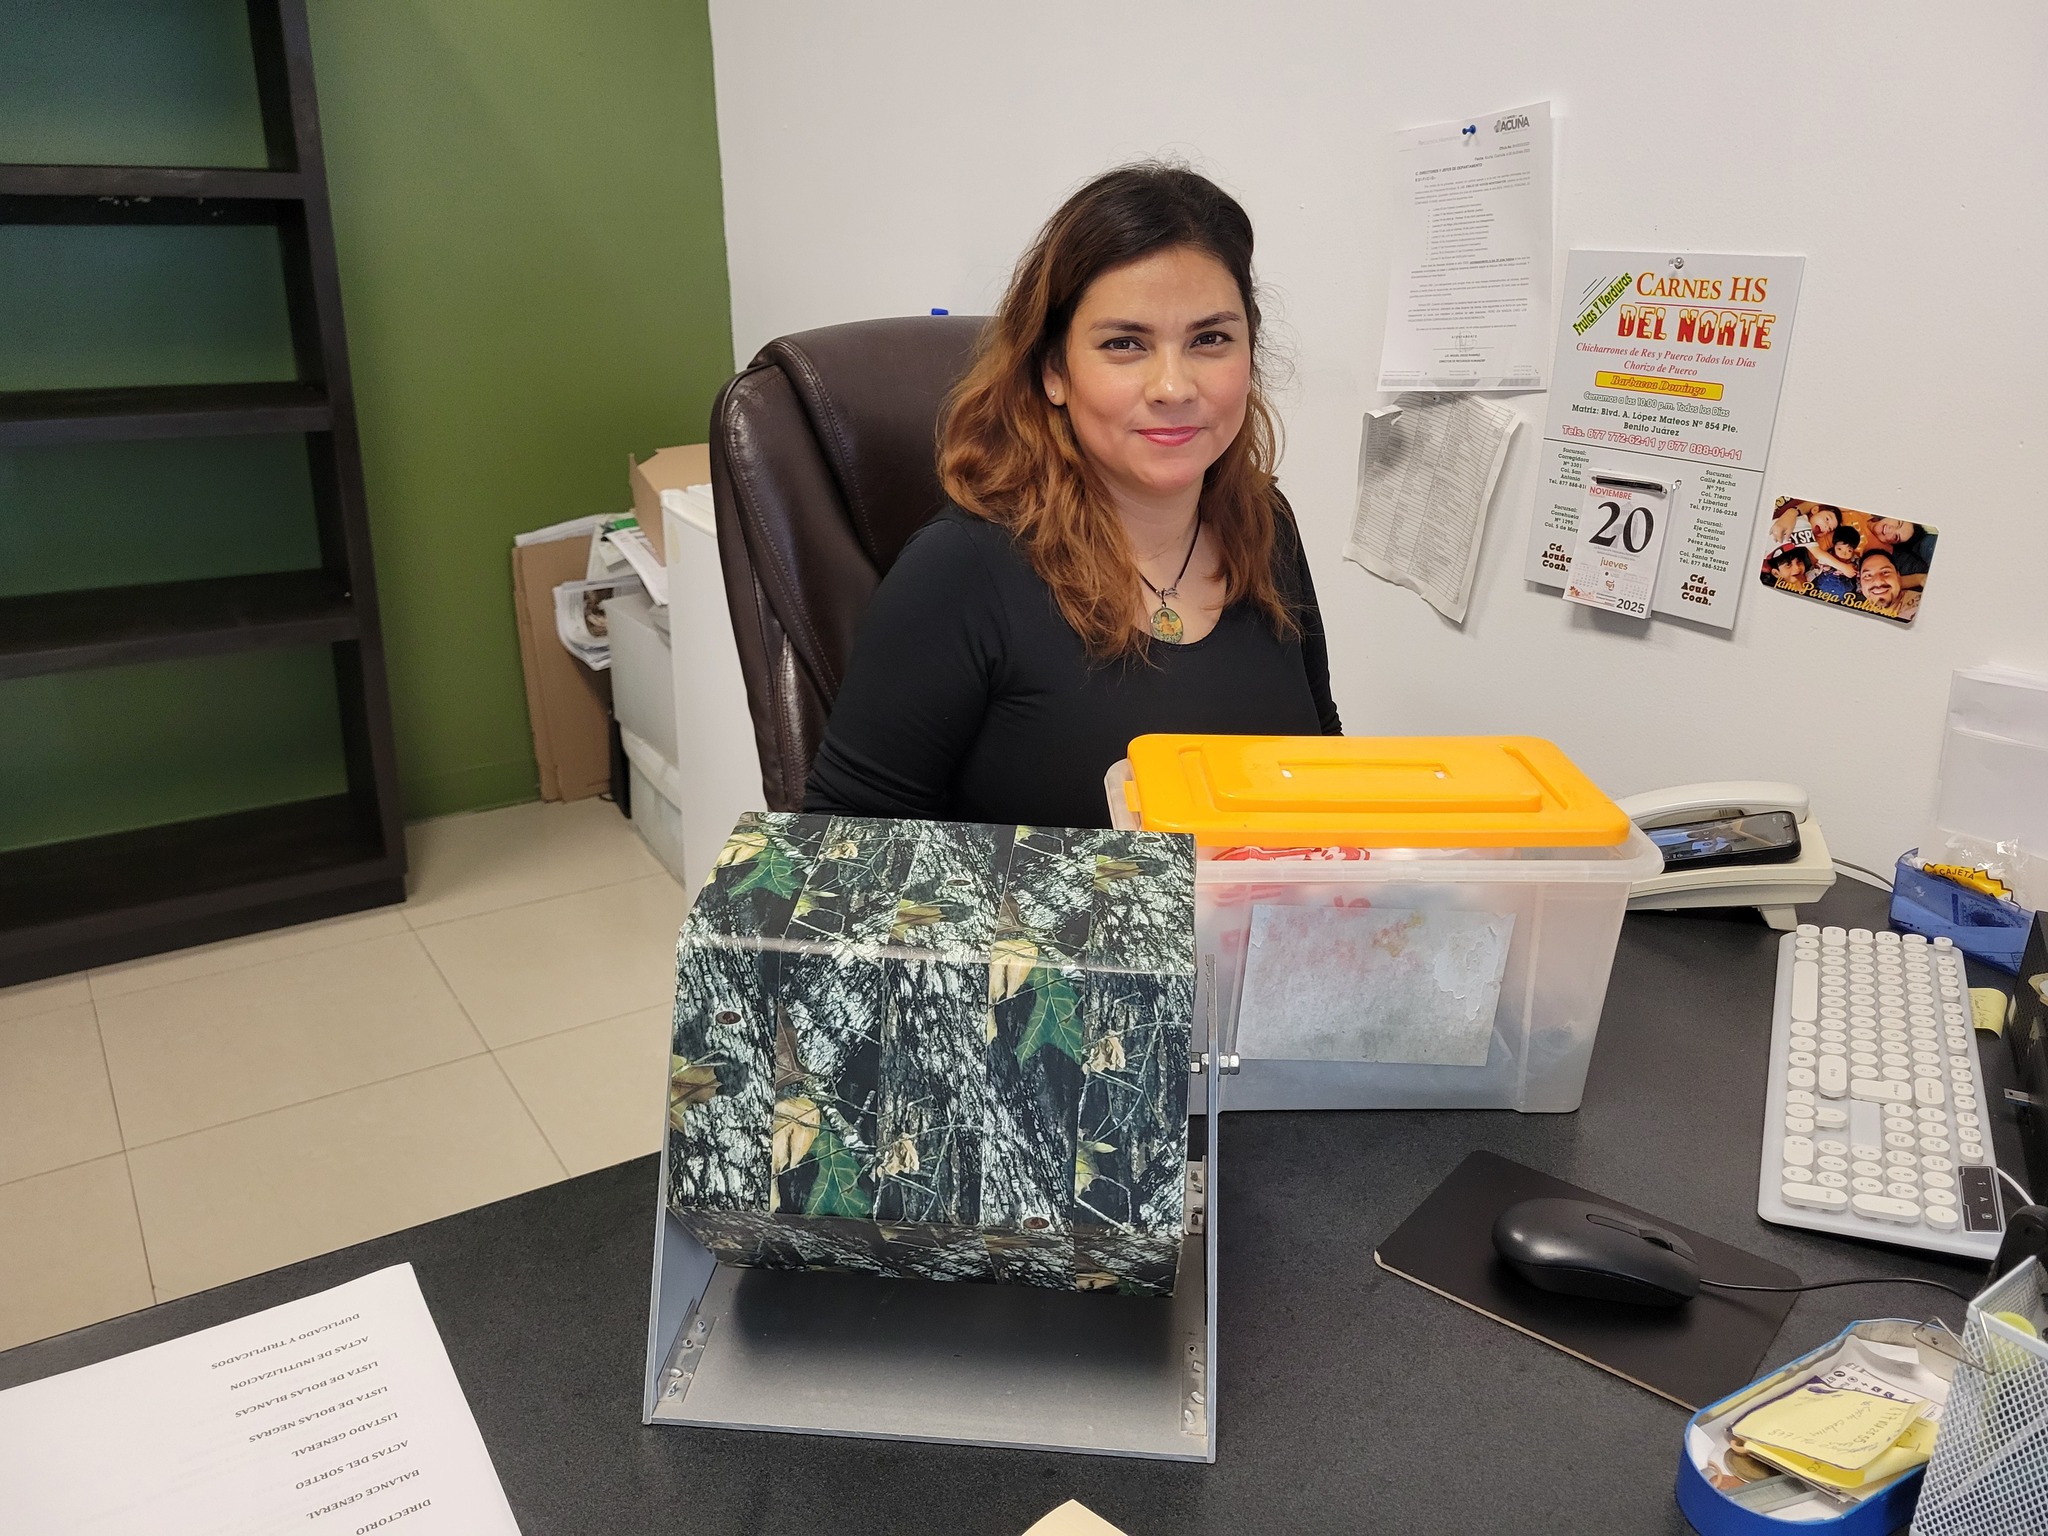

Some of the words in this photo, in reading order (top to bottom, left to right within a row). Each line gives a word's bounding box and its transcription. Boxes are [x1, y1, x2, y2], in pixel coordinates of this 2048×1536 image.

[1500, 115, 1530, 132] ACUÑA
[1729, 277, 1768, 303] HS
[1572, 309, 1598, 336] Frutas
[1593, 301, 1603, 314] Y
[1598, 272, 1633, 308] Verduras
[1617, 304, 1667, 340] DEL
[1677, 308, 1776, 349] NORTE
[1576, 342, 1628, 356] Chicharrones
[1629, 347, 1640, 356] de
[1640, 348, 1656, 358] Res
[1656, 351, 1663, 361] y
[1663, 350, 1693, 362] Puerco
[1695, 353, 1720, 364] Todos
[1721, 356, 1733, 366] los
[1736, 356, 1757, 368] Días
[1623, 360, 1656, 372] Chorizo
[1656, 363, 1666, 373] de
[1668, 364, 1698, 376] Puerco
[1610, 375, 1658, 390] Barbacoa
[1659, 380, 1707, 396] Domingo
[1583, 391, 1618, 403] Cerramos
[1618, 396, 1625, 404] a
[1624, 396, 1637, 406] las
[1637, 397, 1657, 408] 10:00
[1657, 401, 1675, 411] p.m.
[1676, 402, 1699, 414] Todos
[1699, 404, 1711, 415] los
[1711, 406, 1730, 418] Días
[1572, 404, 1600, 414] Matriz:
[1600, 408, 1620, 417] Blvd.
[1622, 410, 1631, 419] A.
[1632, 411, 1657, 423] López
[1659, 415, 1690, 427] Mateos
[1704, 421, 1720, 431] 854
[1722, 423, 1739, 433] Pte.
[1623, 421, 1650, 432] Benito
[1650, 425, 1680, 437] Juárez
[1562, 425, 1586, 438] Tels.
[1586, 429, 1606, 440] 877
[1607, 432, 1656, 448] 772-62-11
[1658, 440, 1666, 451] y
[1667, 440, 1688, 452] 877
[1689, 443, 1743, 461] 888-01-11
[1589, 486, 1632, 500] NOVIEMBRE
[1588, 501, 1654, 553] 20
[1541, 550, 1573, 564] Acuña
[1549, 543, 1564, 553] Cd.
[1542, 560, 1569, 572] Coah.
[1600, 556, 1628, 570] jueves
[1681, 582, 1716, 597] Acuña
[1690, 574, 1707, 585] Cd.
[1616, 598, 1645, 614] 2025
[1682, 591, 1712, 606] Coah.
[1939, 868, 1974, 880] CAJETA
[298, 1313, 360, 1340] DUPLICADO
[316, 1349, 333, 1360] DE
[334, 1336, 369, 1353] ACTAS
[210, 1340, 288, 1370] TRIPLICADOS
[229, 1356, 315, 1391] INUTILIZACION
[329, 1373, 345, 1384] DE
[347, 1361, 379, 1377] LISTA
[290, 1380, 327, 1399] BOLAS
[356, 1386, 388, 1402] LISTA
[235, 1394, 288, 1418] BLANCAS
[338, 1399, 354, 1410] DE
[298, 1405, 336, 1425] BOLAS
[349, 1412, 398, 1436] LISTADO
[248, 1421, 296, 1443] NEGRAS
[291, 1432, 346, 1457] GENERAL
[371, 1440, 409, 1460] ACTAS
[345, 1455, 369, 1470] DEL
[295, 1465, 345, 1490] SORTEO
[365, 1469, 420, 1497] BALANCE
[305, 1492, 363, 1520] GENERAL
[355, 1499, 432, 1536] DIRECTORIO
